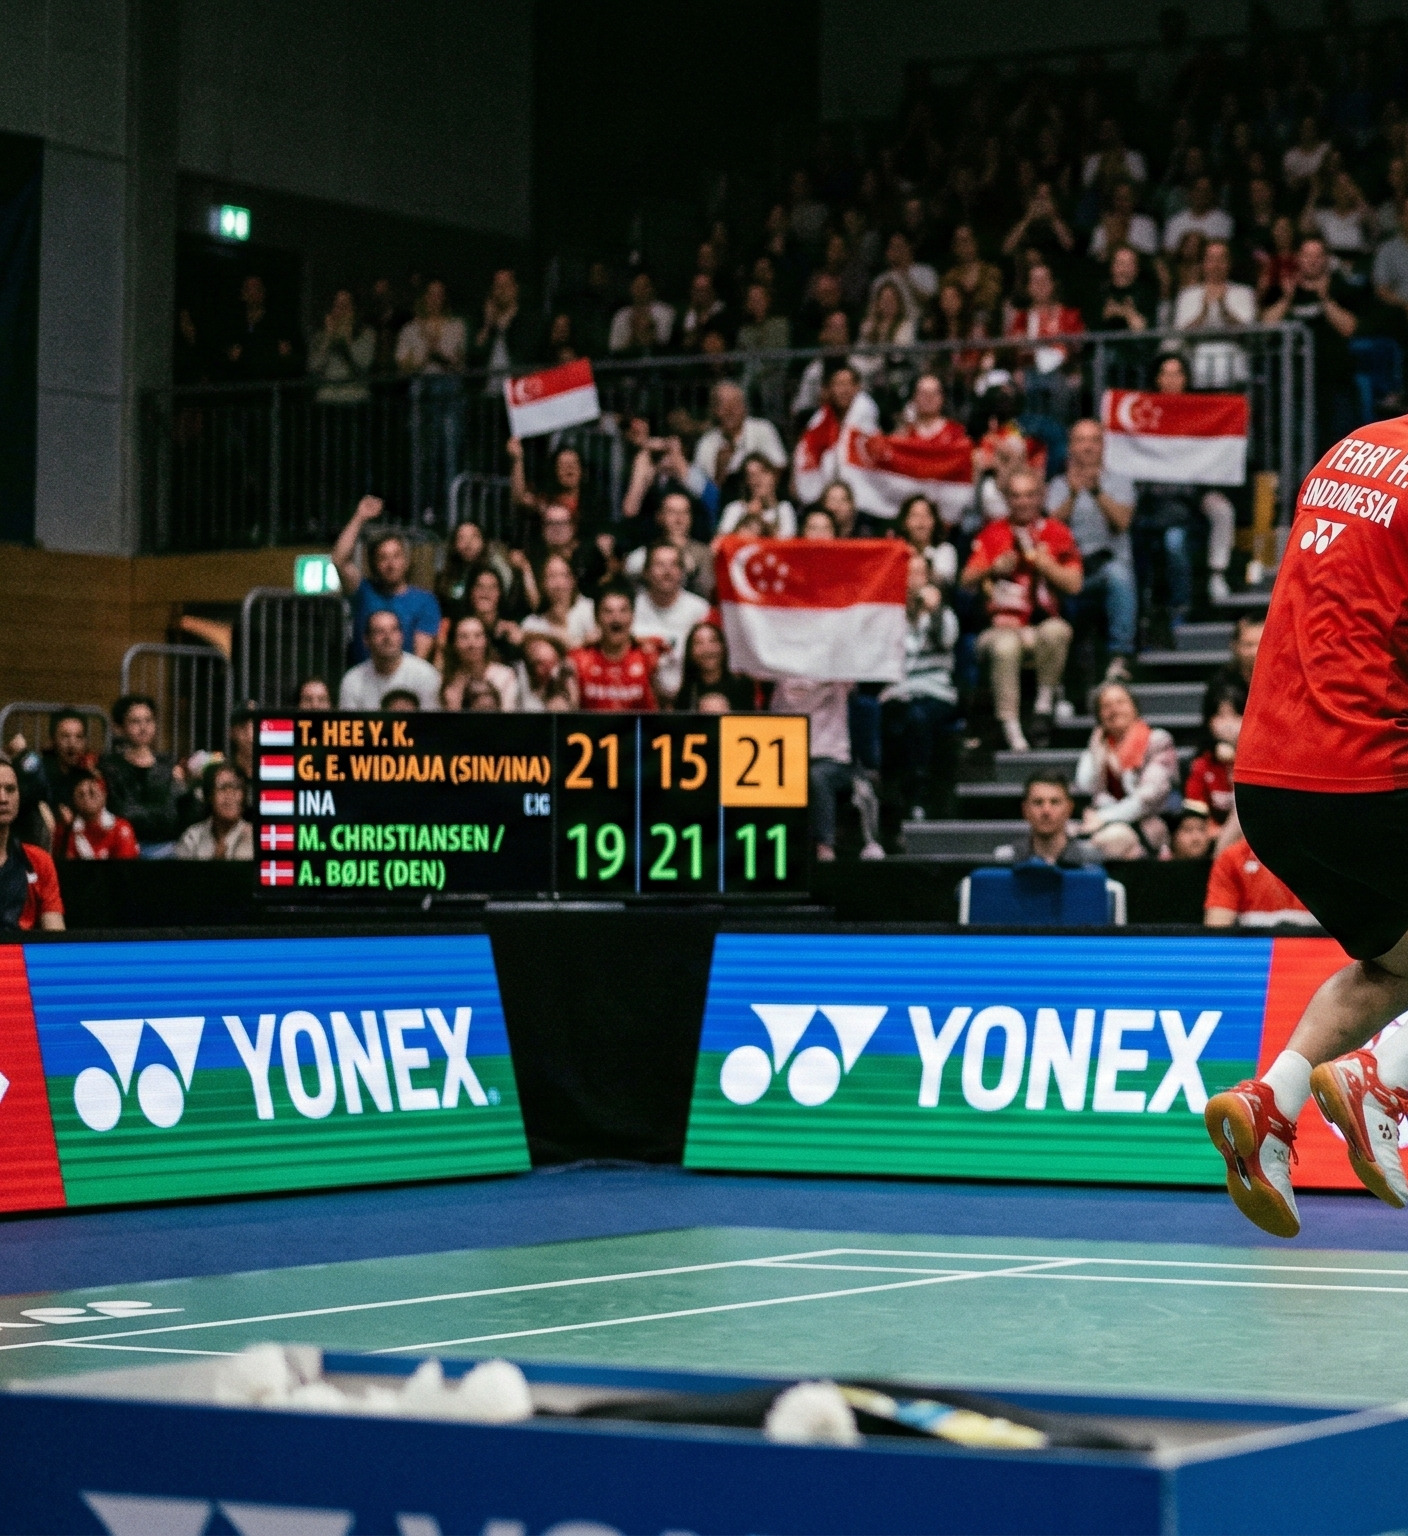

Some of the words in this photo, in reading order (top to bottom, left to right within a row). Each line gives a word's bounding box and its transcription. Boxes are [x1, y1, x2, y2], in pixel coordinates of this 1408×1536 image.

[1326, 438, 1401, 478] TERRY
[1303, 478, 1398, 528] INDONESIA
[298, 720, 317, 747] T.
[323, 720, 364, 747] HEE
[368, 720, 388, 747] Y.
[392, 720, 414, 747] K.
[298, 755, 321, 782] G.
[326, 755, 346, 782] E.
[350, 755, 446, 782] WIDJAJA
[450, 755, 550, 786] (SIN/INA)
[564, 732, 619, 790] 21
[652, 733, 708, 791] 15
[736, 736, 785, 787] 21
[298, 790, 336, 816] INA
[298, 824, 326, 851] M.
[330, 824, 489, 851] CHRISTIANSEN
[566, 823, 626, 880] 19
[649, 823, 702, 880] 21
[736, 823, 786, 880] 11
[298, 859, 321, 886] A.
[326, 859, 380, 887] BØJE
[384, 859, 446, 890] (DEN)
[222, 1007, 489, 1120] YONEX
[908, 1005, 1223, 1114] YONEX
